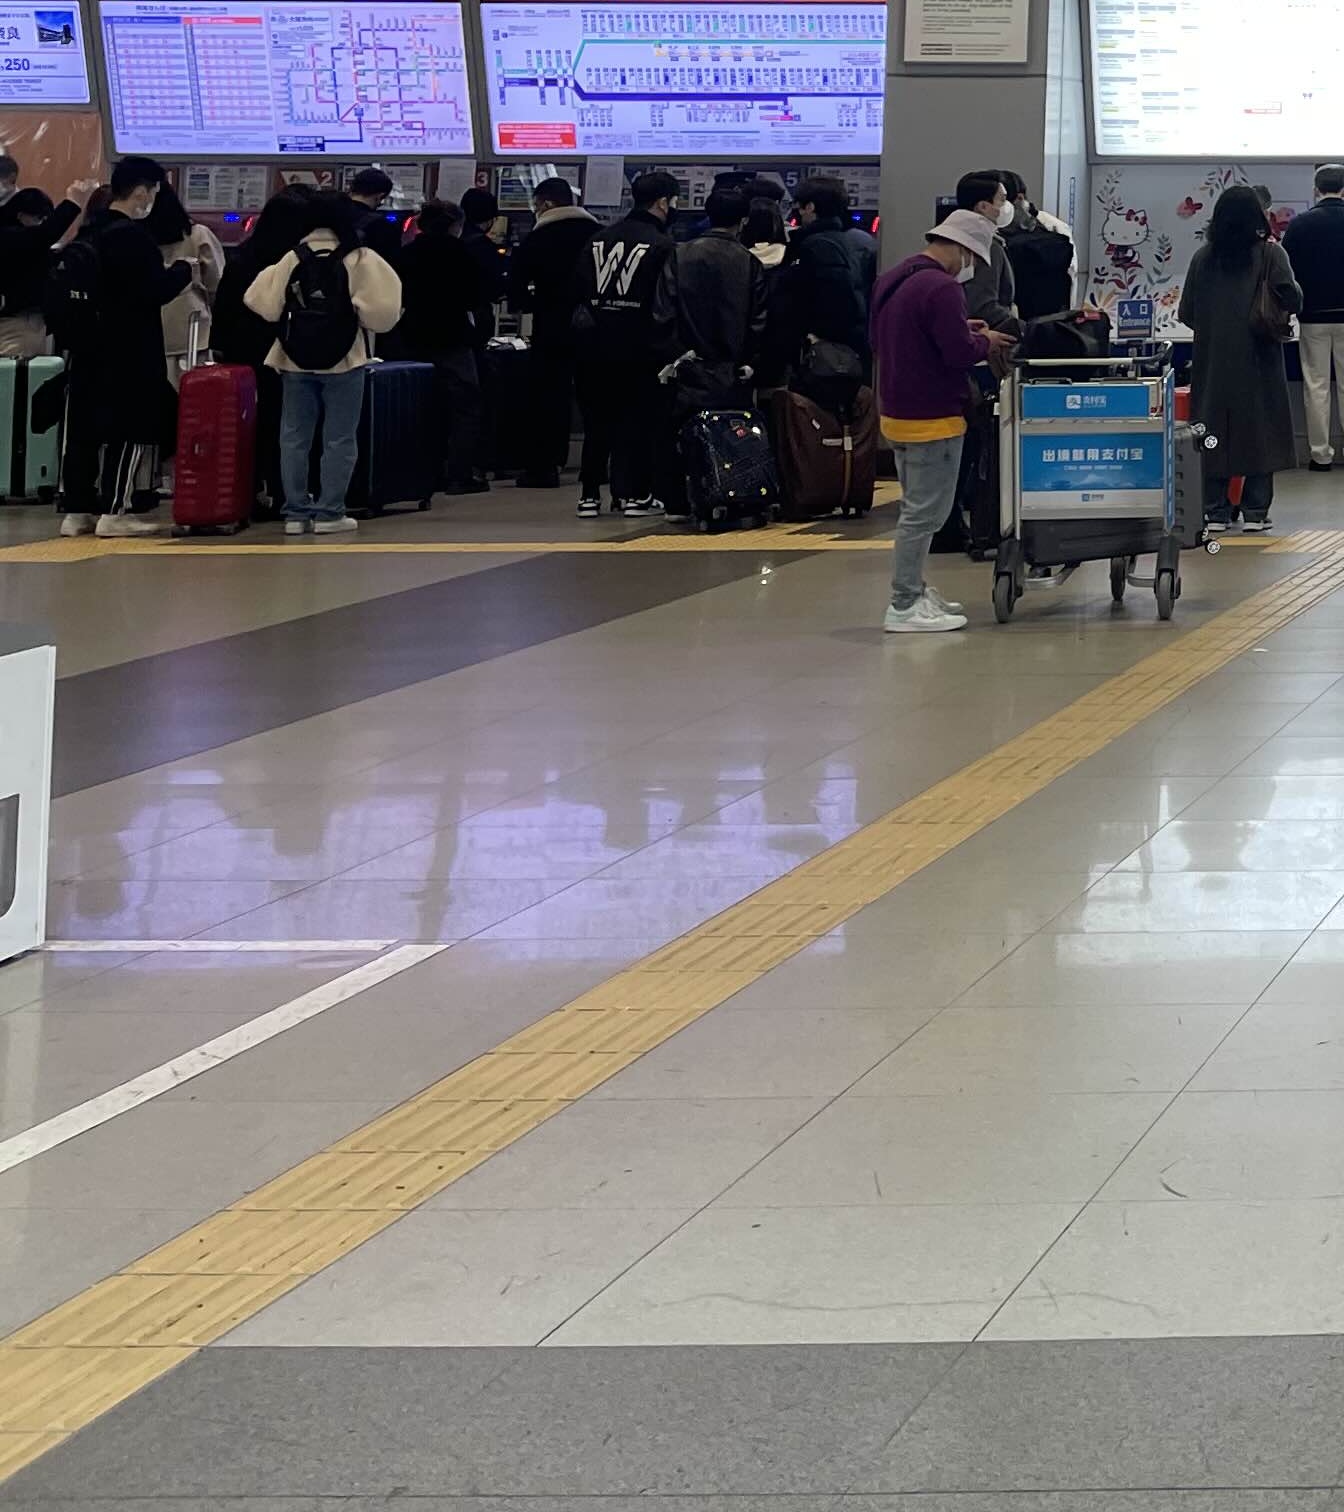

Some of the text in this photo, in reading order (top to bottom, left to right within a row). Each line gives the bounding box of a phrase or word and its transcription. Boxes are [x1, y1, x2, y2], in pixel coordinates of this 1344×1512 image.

[320, 171, 333, 187] 2
[476, 172, 488, 187] 3
[1121, 303, 1149, 316] 入口
